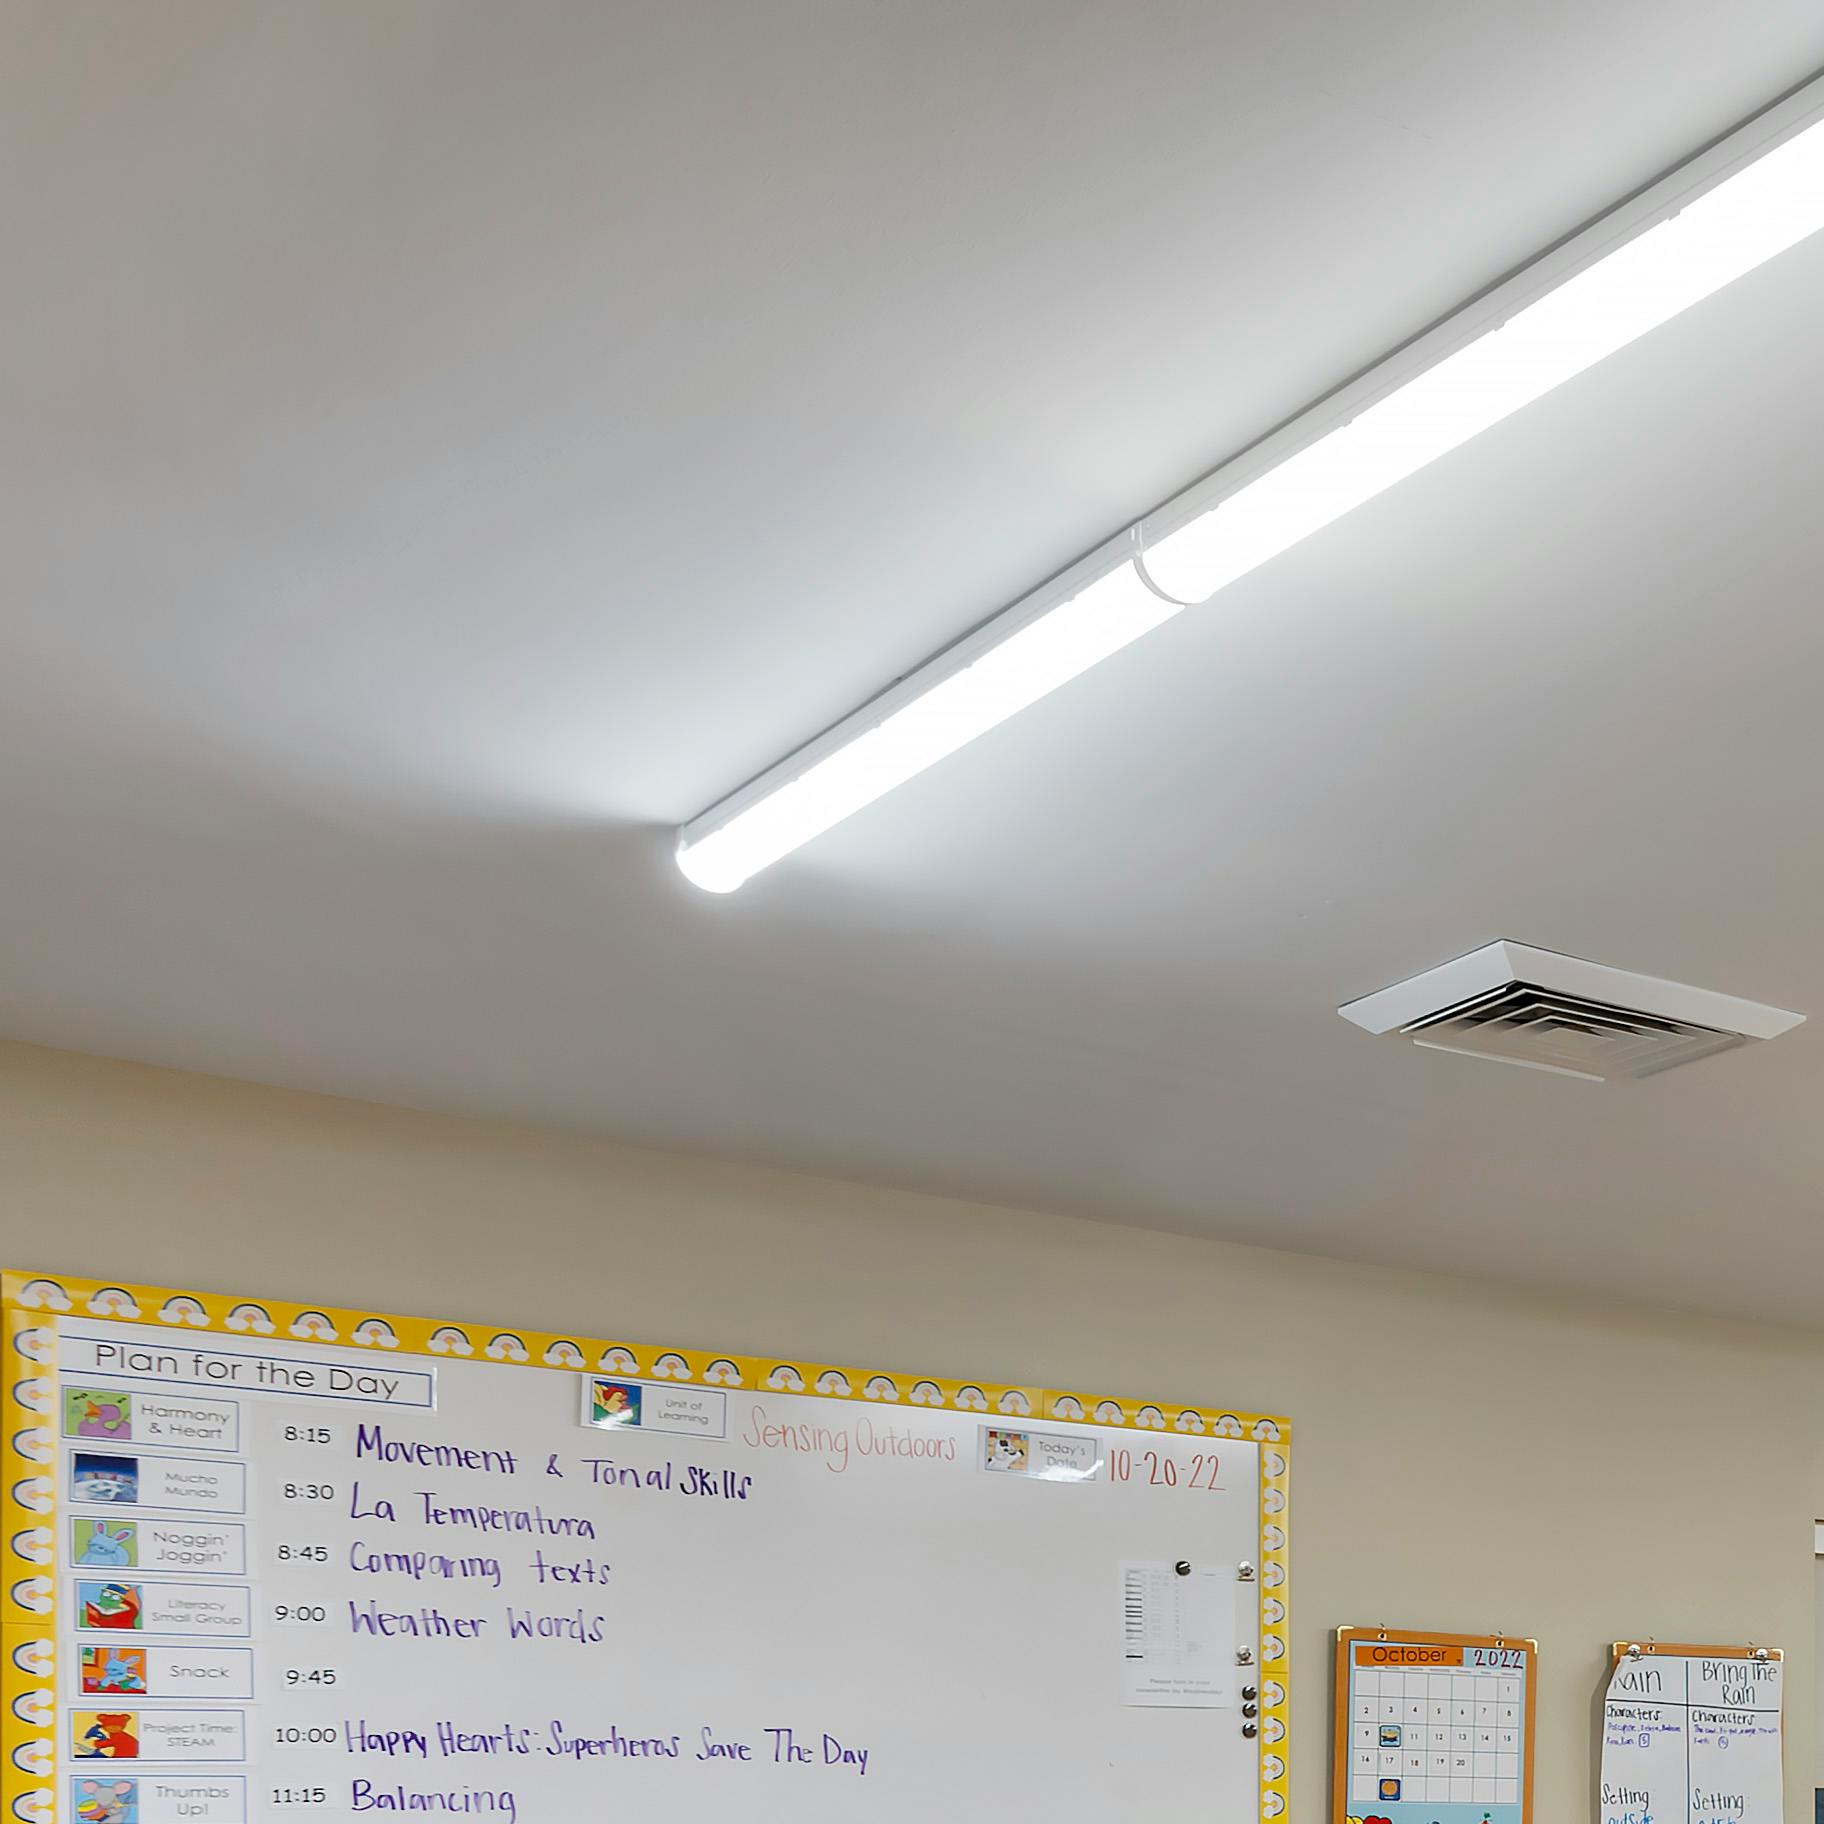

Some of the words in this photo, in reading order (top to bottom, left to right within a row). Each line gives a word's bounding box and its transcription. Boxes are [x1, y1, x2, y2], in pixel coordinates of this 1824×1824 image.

[96, 1344, 178, 1374] Plan
[193, 1354, 242, 1380] for
[256, 1361, 315, 1388] the
[329, 1367, 400, 1400] Day
[665, 1400, 687, 1408] Unit
[691, 1402, 703, 1410] of
[141, 1404, 230, 1425] Harmony
[658, 1411, 709, 1425] Learning
[149, 1422, 162, 1434] &
[170, 1424, 222, 1440] Heart
[284, 1426, 331, 1444] 8:15
[743, 1405, 849, 1473] Sensing
[855, 1416, 956, 1461] Outdoors
[1037, 1438, 1087, 1457] Today's
[356, 1423, 519, 1474] Movement
[546, 1454, 564, 1478] &
[580, 1459, 671, 1490] Tonal
[679, 1465, 753, 1500] Skills
[1109, 1448, 1227, 1492] 10-20-22
[166, 1473, 218, 1485] Mucho
[284, 1483, 335, 1500] 8:30
[350, 1481, 397, 1522] La
[413, 1492, 596, 1540] Temperatura
[153, 1531, 230, 1548] Noggin'
[156, 1548, 228, 1564] Joggin'
[277, 1545, 328, 1562] 8:45
[350, 1541, 501, 1588] Comparing
[528, 1550, 611, 1586] texts
[168, 1599, 226, 1612] Literacy
[275, 1605, 326, 1622] 9:00
[152, 1611, 192, 1624] Small
[195, 1613, 243, 1626] Group
[349, 1600, 488, 1638] Weather
[506, 1606, 606, 1644] Words
[1372, 1646, 1448, 1663] October
[1474, 1649, 1523, 1669] 2022
[169, 1665, 230, 1679] Snack
[286, 1669, 337, 1685] 9:45
[1702, 1660, 1747, 1689] Bring
[1750, 1661, 1777, 1682] The
[1722, 1685, 1756, 1706] Rain
[1692, 1710, 1756, 1726] Characters
[143, 1723, 197, 1736] Project
[275, 1728, 337, 1744] 10:00
[166, 1737, 215, 1748] STEAM
[344, 1719, 428, 1759] Happy
[696, 1726, 753, 1762] Save
[763, 1728, 815, 1763] The
[822, 1733, 870, 1774] Day
[156, 1786, 230, 1799] Thumbs
[273, 1788, 326, 1804] 11:15
[176, 1803, 209, 1817] Up!
